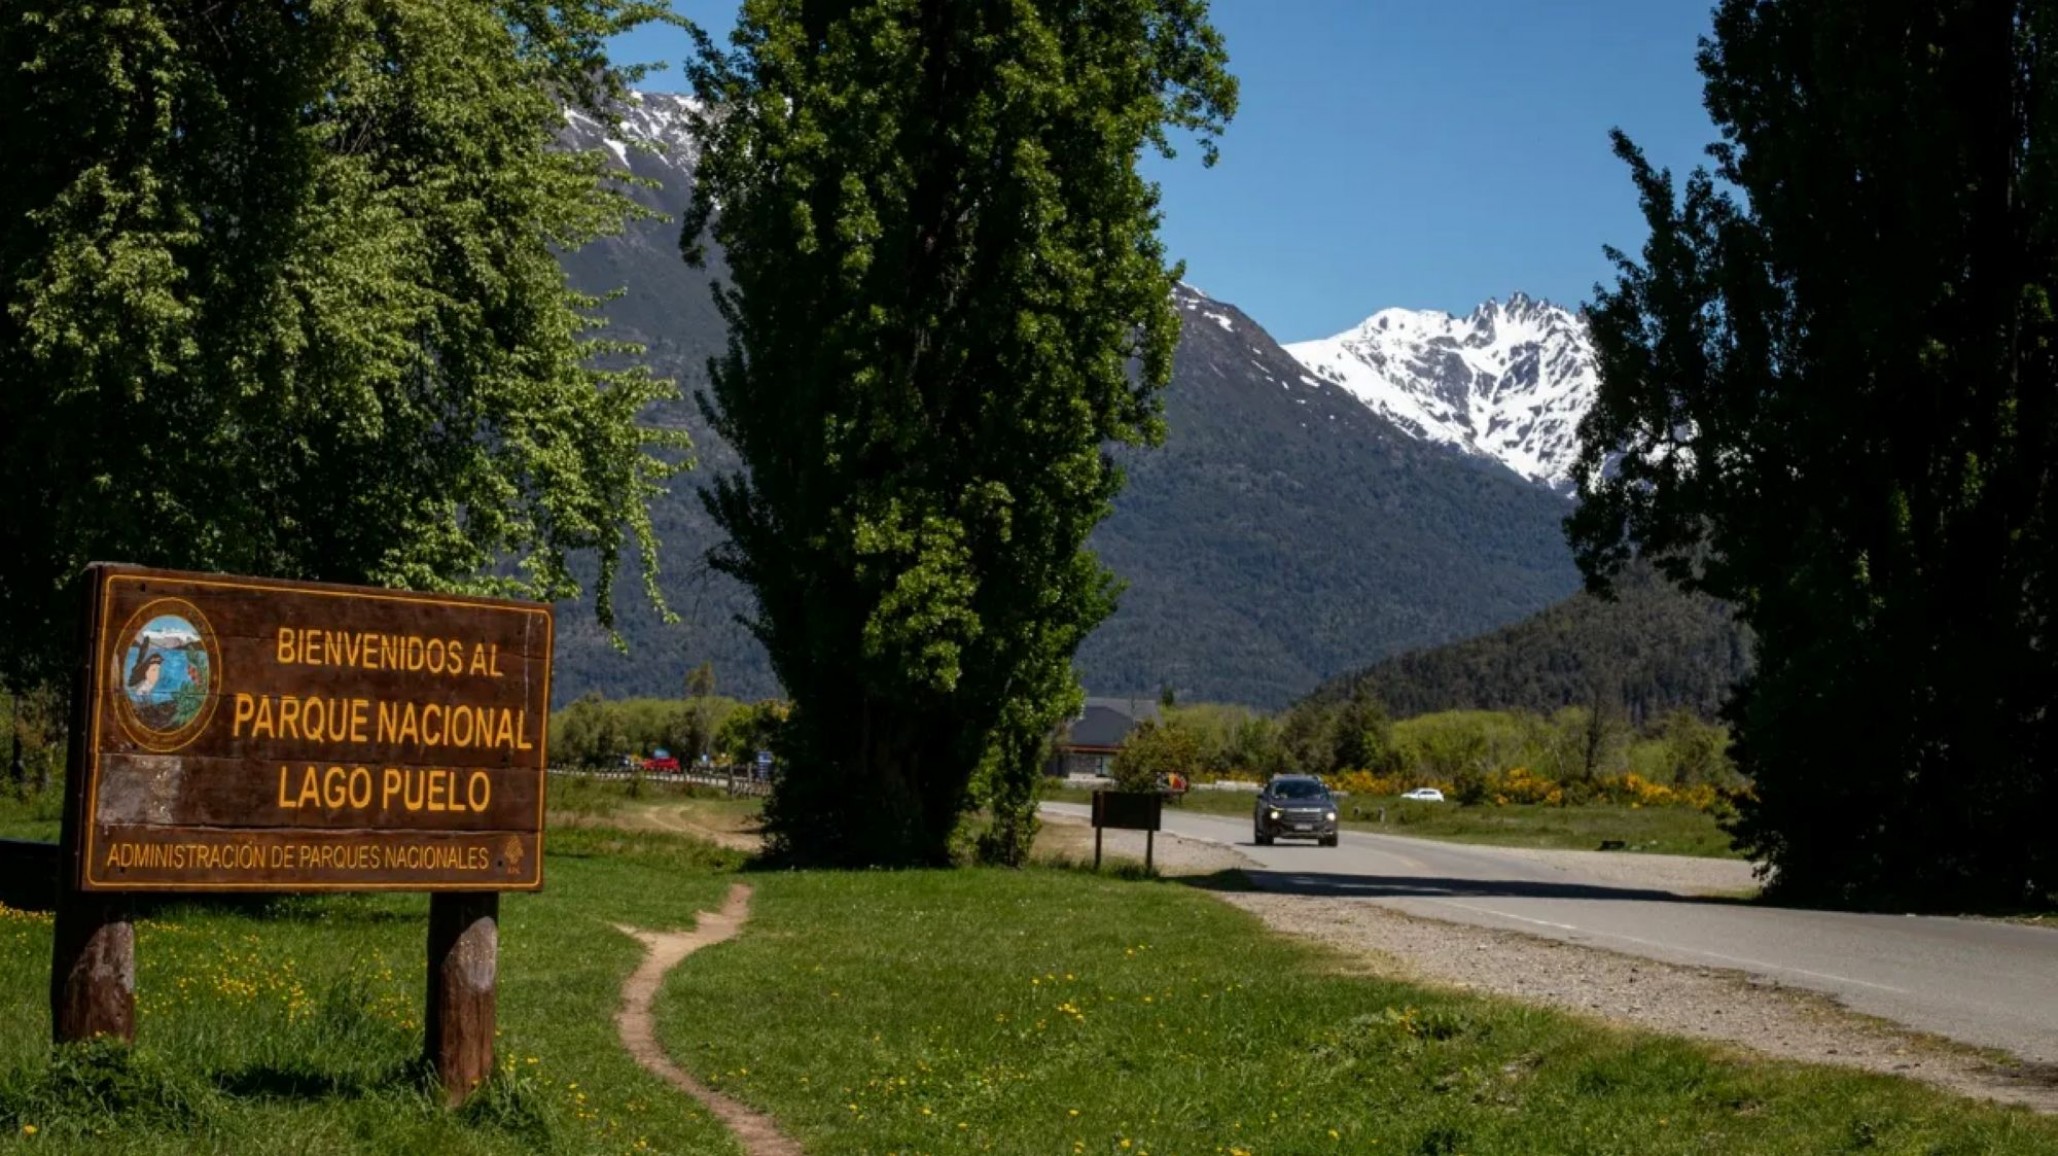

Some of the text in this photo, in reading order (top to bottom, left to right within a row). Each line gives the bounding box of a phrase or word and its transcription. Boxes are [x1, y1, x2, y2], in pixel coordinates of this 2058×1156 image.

[277, 627, 503, 677] BIENVENIDOS AL
[233, 692, 532, 750] PARQUE NACIONAL
[278, 766, 490, 811] LAGO PUELO
[106, 840, 489, 869] ADMINISTRACIÓN DE PARQUES NACIONALES
